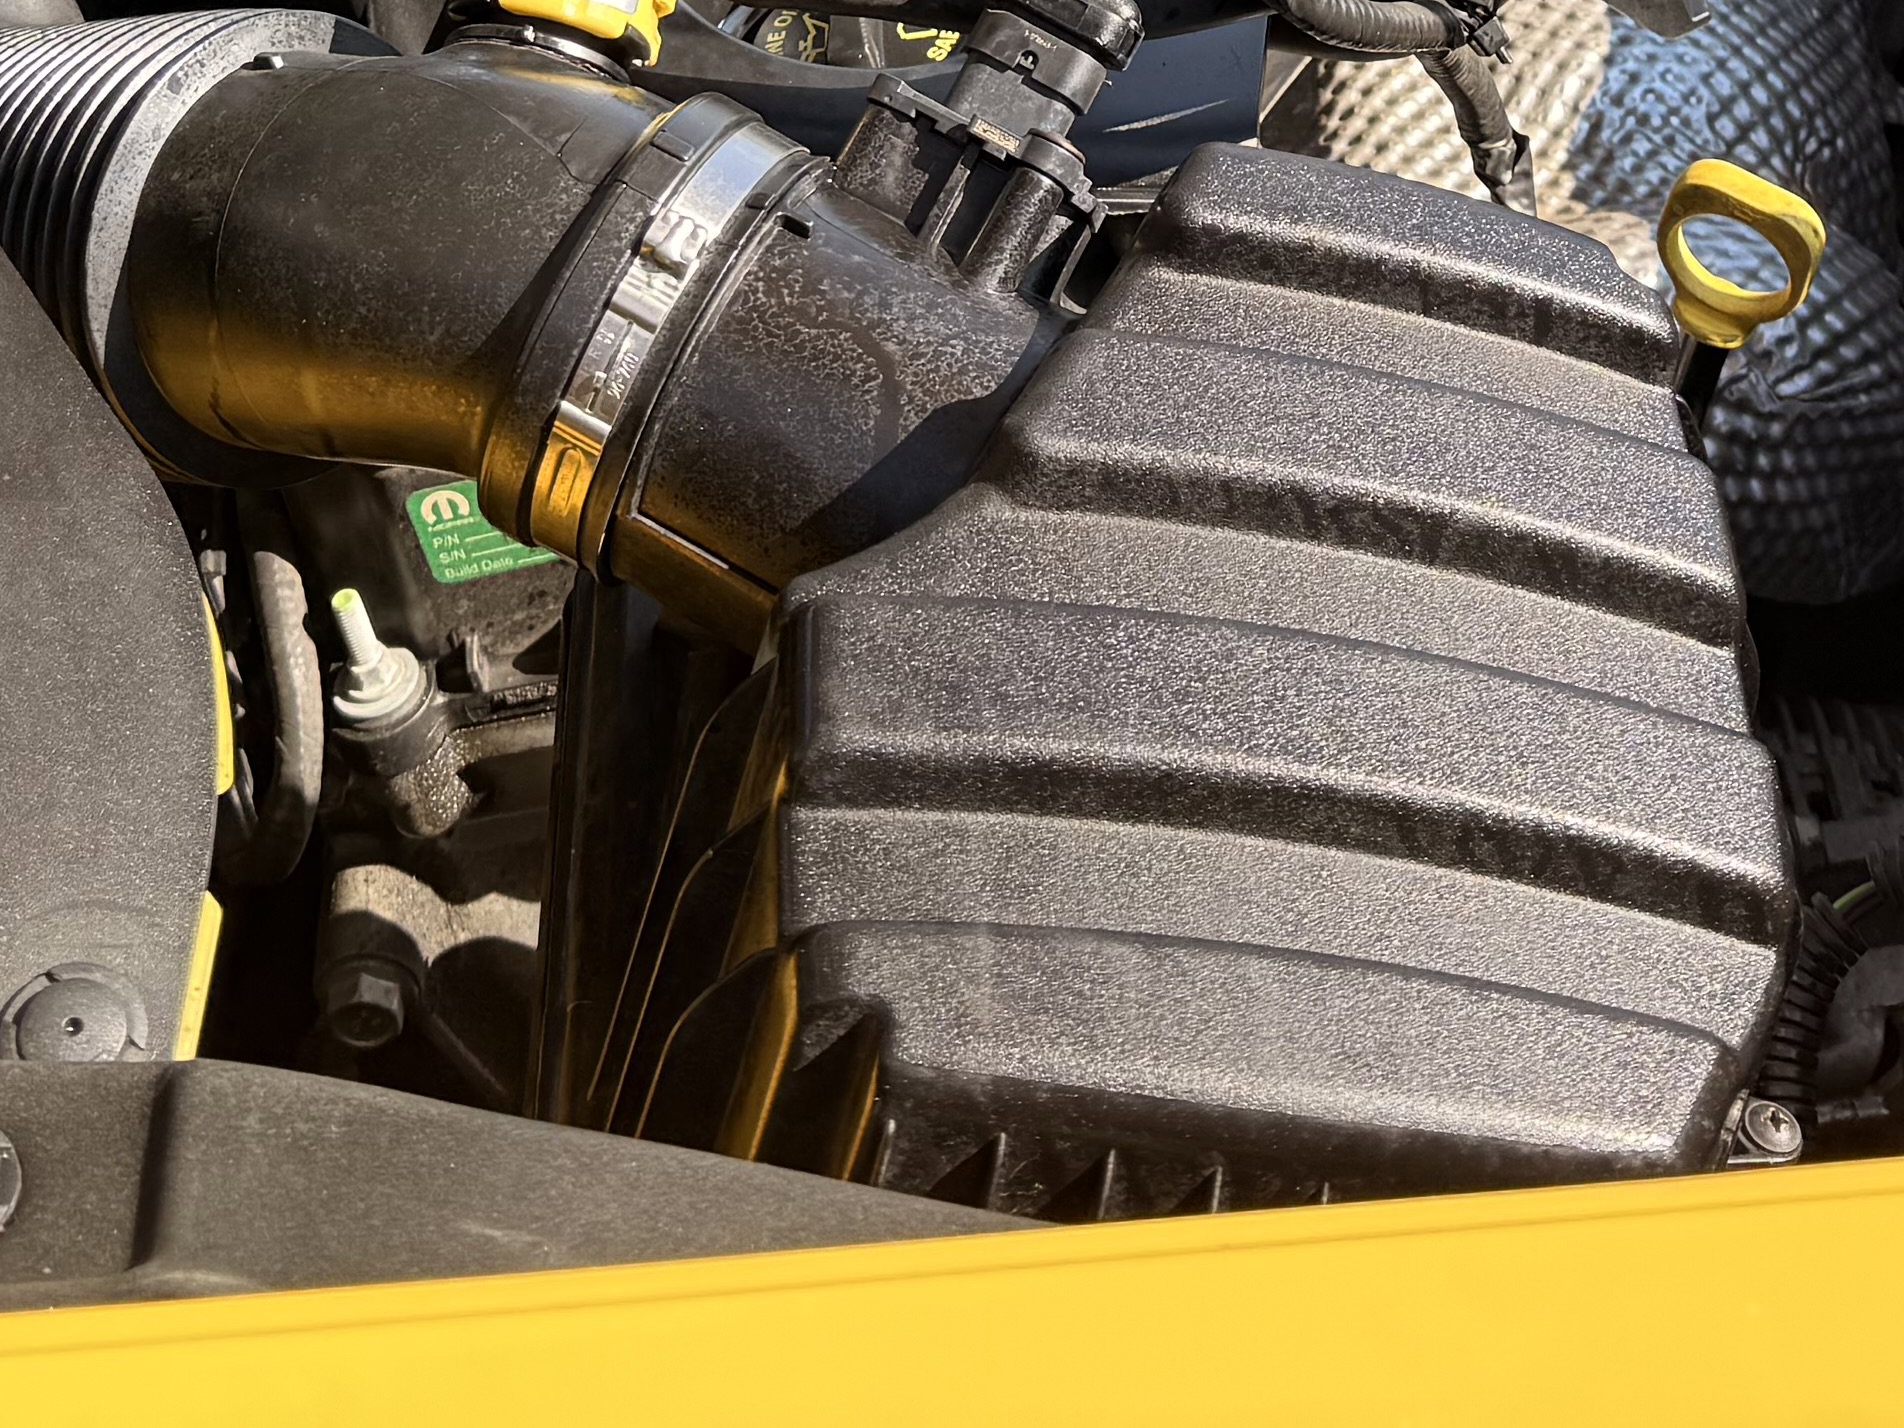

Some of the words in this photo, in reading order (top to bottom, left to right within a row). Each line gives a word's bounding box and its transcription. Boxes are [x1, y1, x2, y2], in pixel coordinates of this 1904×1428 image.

[927, 30, 960, 61] SAE
[432, 534, 460, 549] P/N
[439, 549, 466, 564] S/N
[444, 564, 479, 579] Build
